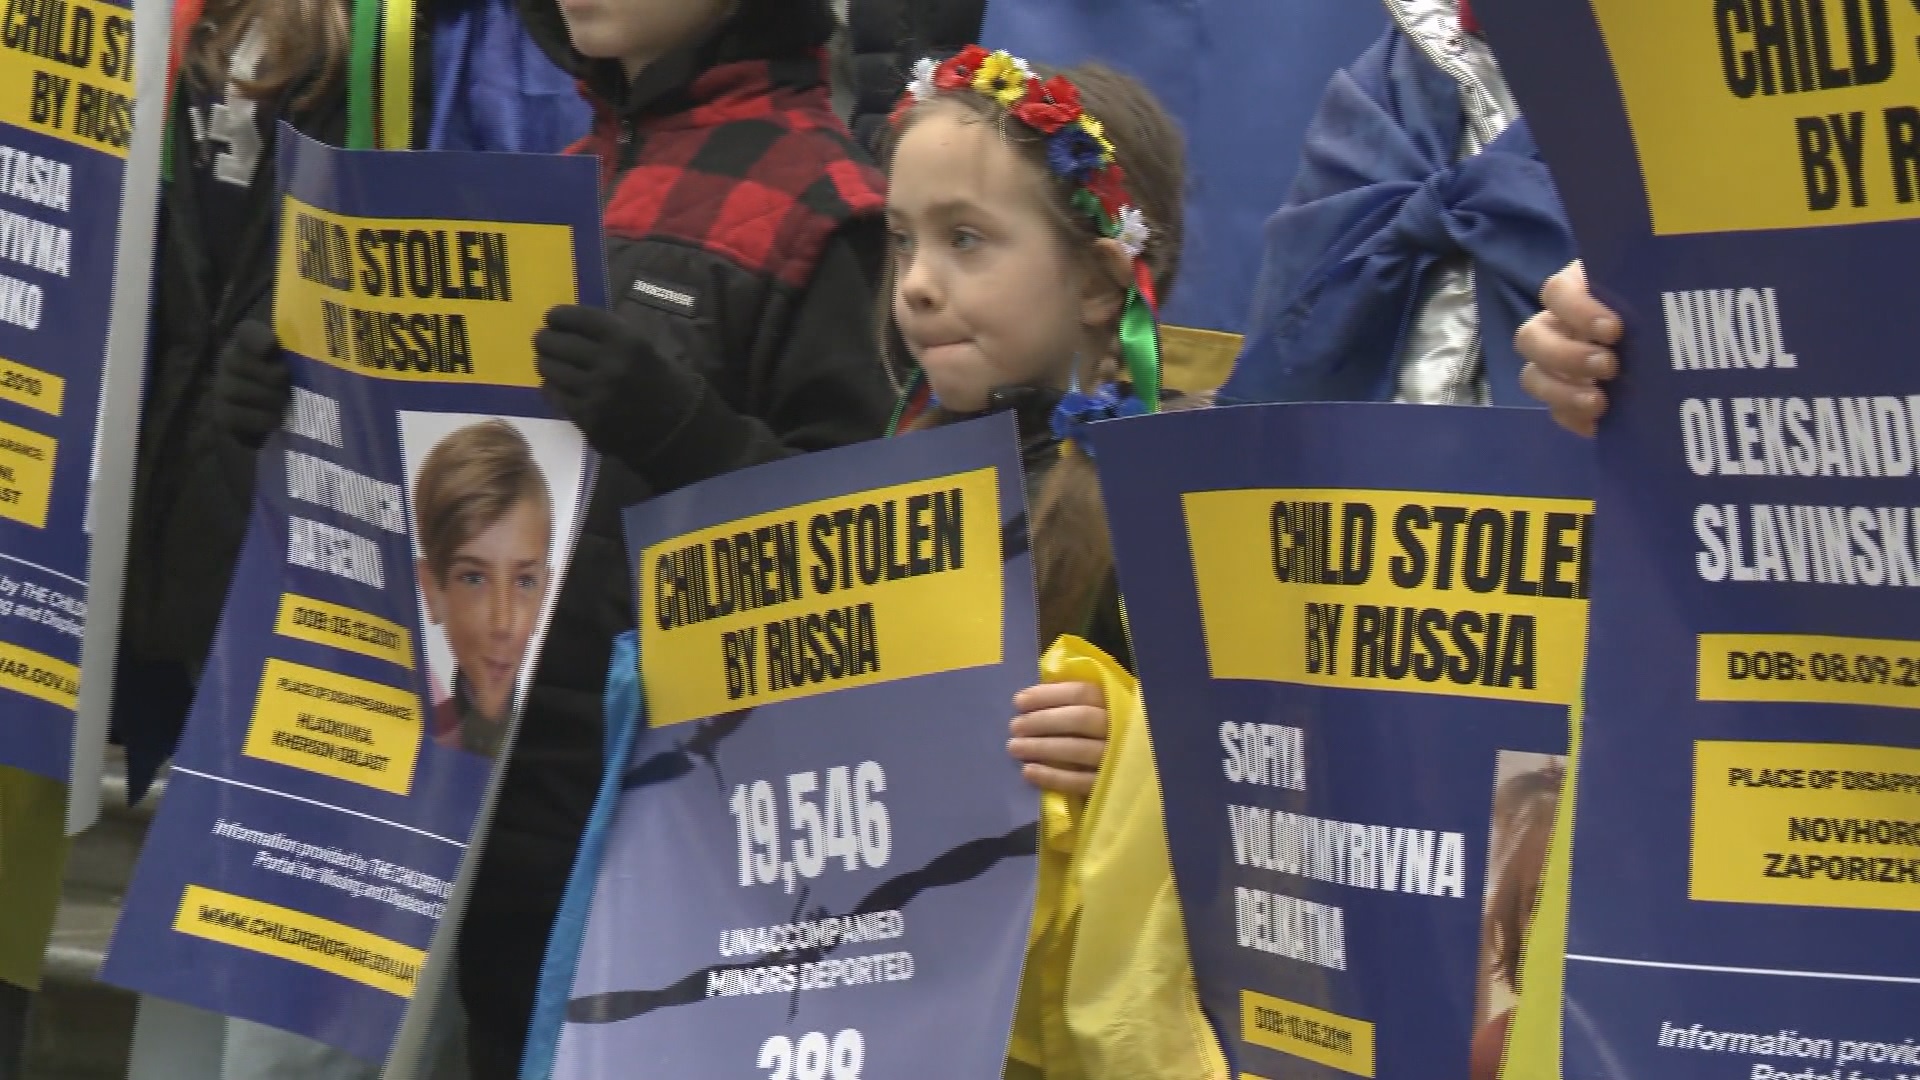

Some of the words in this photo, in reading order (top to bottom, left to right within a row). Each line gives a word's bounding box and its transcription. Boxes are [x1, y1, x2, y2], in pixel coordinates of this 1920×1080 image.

[1, 0, 95, 68] CHILD
[1713, 0, 1895, 98] CHILD
[29, 70, 70, 128] BY
[0, 146, 71, 212] TASIA
[1794, 111, 1867, 210] BY
[295, 211, 354, 291] CHILD
[355, 227, 512, 301] STOLEN
[632, 278, 695, 307] DISCOVER
[320, 298, 350, 361] BY
[348, 306, 474, 374] RUSSIA
[1661, 287, 1797, 370] NIKOL
[654, 520, 801, 632] CHILDREN
[807, 487, 963, 594] STOLEN
[1269, 500, 1376, 585] CHILD
[1692, 503, 1920, 586] SLAVINSK
[13, 603, 40, 622] and
[20, 581, 49, 603] THE
[720, 627, 757, 700] BY
[763, 602, 879, 692] RUSSIA
[1304, 602, 1343, 676] BY
[1351, 605, 1536, 689] RUSSIA
[1726, 651, 1806, 681] DOB:
[1218, 720, 1306, 791] SOFIYA
[1727, 768, 1805, 788] PLACE
[1807, 769, 1839, 789] OF
[211, 818, 299, 853] Information
[368, 858, 393, 880] THE
[728, 760, 891, 894] 19,546
[1227, 804, 1465, 898] VOLODYMYRIVNA
[251, 850, 298, 878] Portal
[297, 861, 320, 881] for
[316, 866, 363, 898] Missing
[361, 881, 386, 902] and
[1762, 852, 1920, 884] ZAPORIZH
[719, 909, 903, 957] UNACCOMPANIED
[1234, 886, 1346, 971] DELIKATNA
[705, 965, 798, 997] MINORS
[799, 951, 914, 991] DEPORTED
[1254, 1004, 1286, 1034] DOB:
[1657, 1020, 1832, 1059] Information
